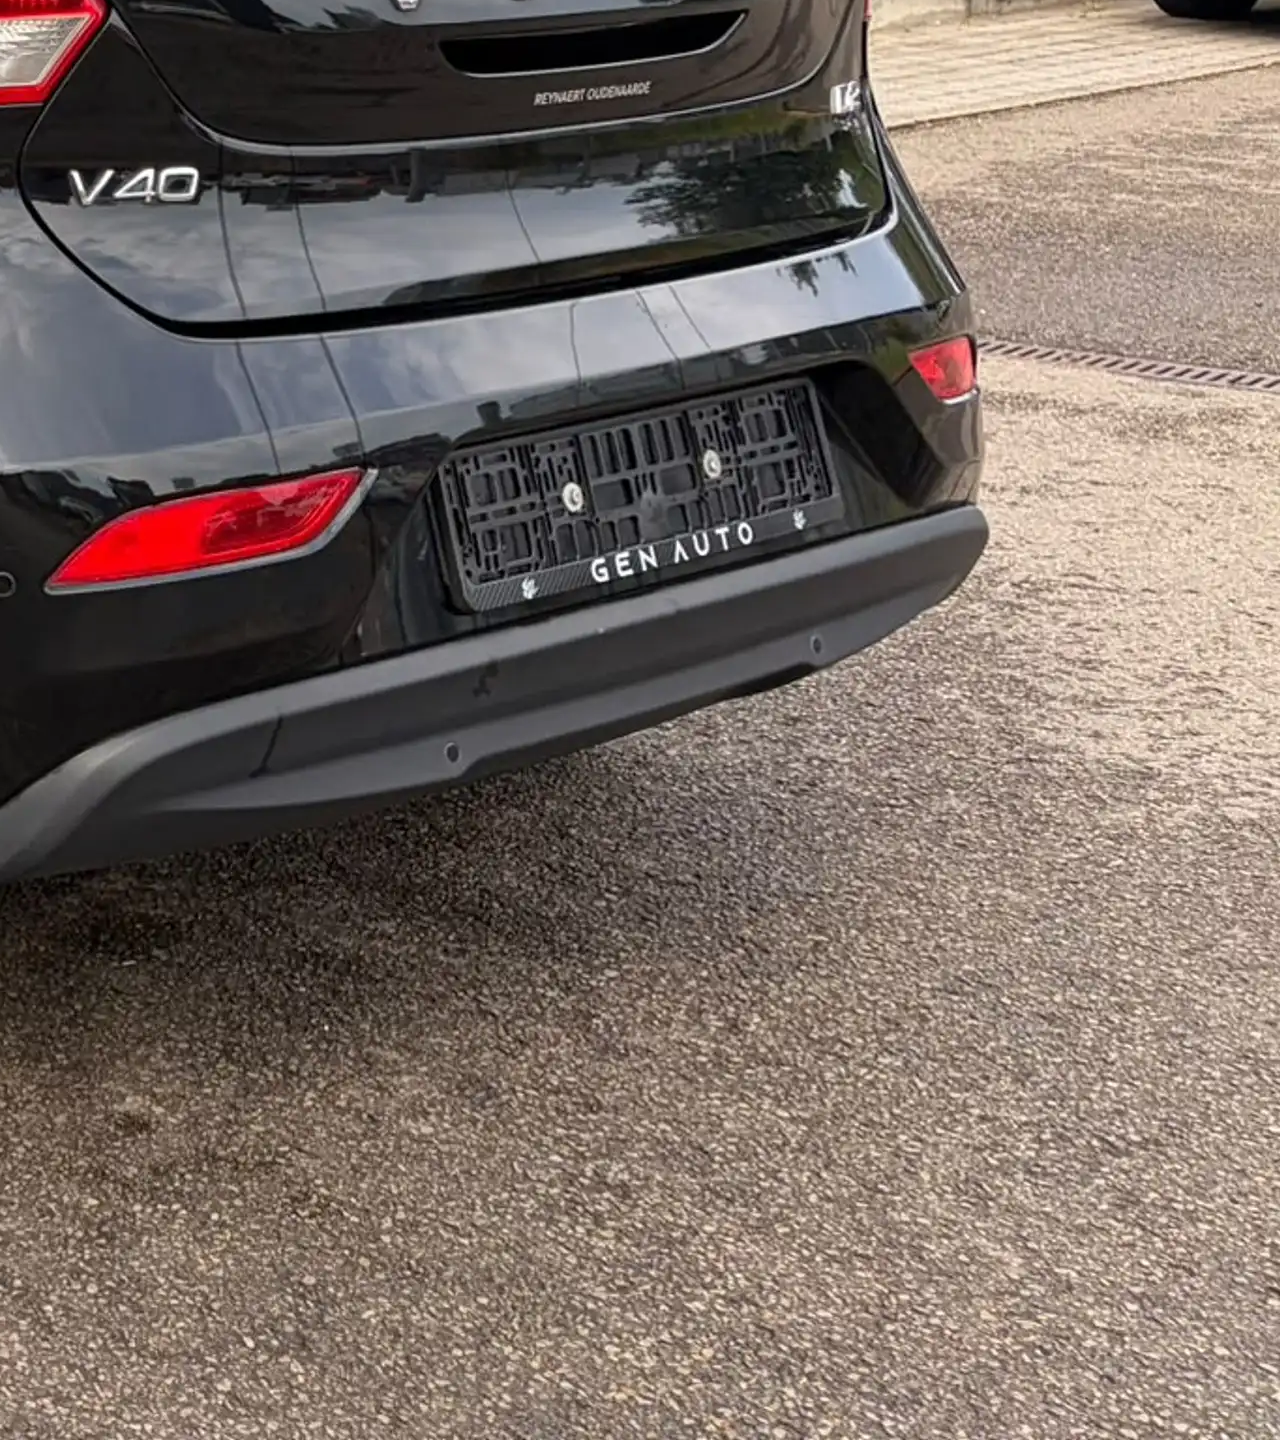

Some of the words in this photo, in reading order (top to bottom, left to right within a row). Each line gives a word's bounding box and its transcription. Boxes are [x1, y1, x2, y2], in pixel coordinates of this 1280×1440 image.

[69, 166, 200, 206] V40
[590, 545, 659, 584] GEN
[673, 521, 754, 565] AUTO
